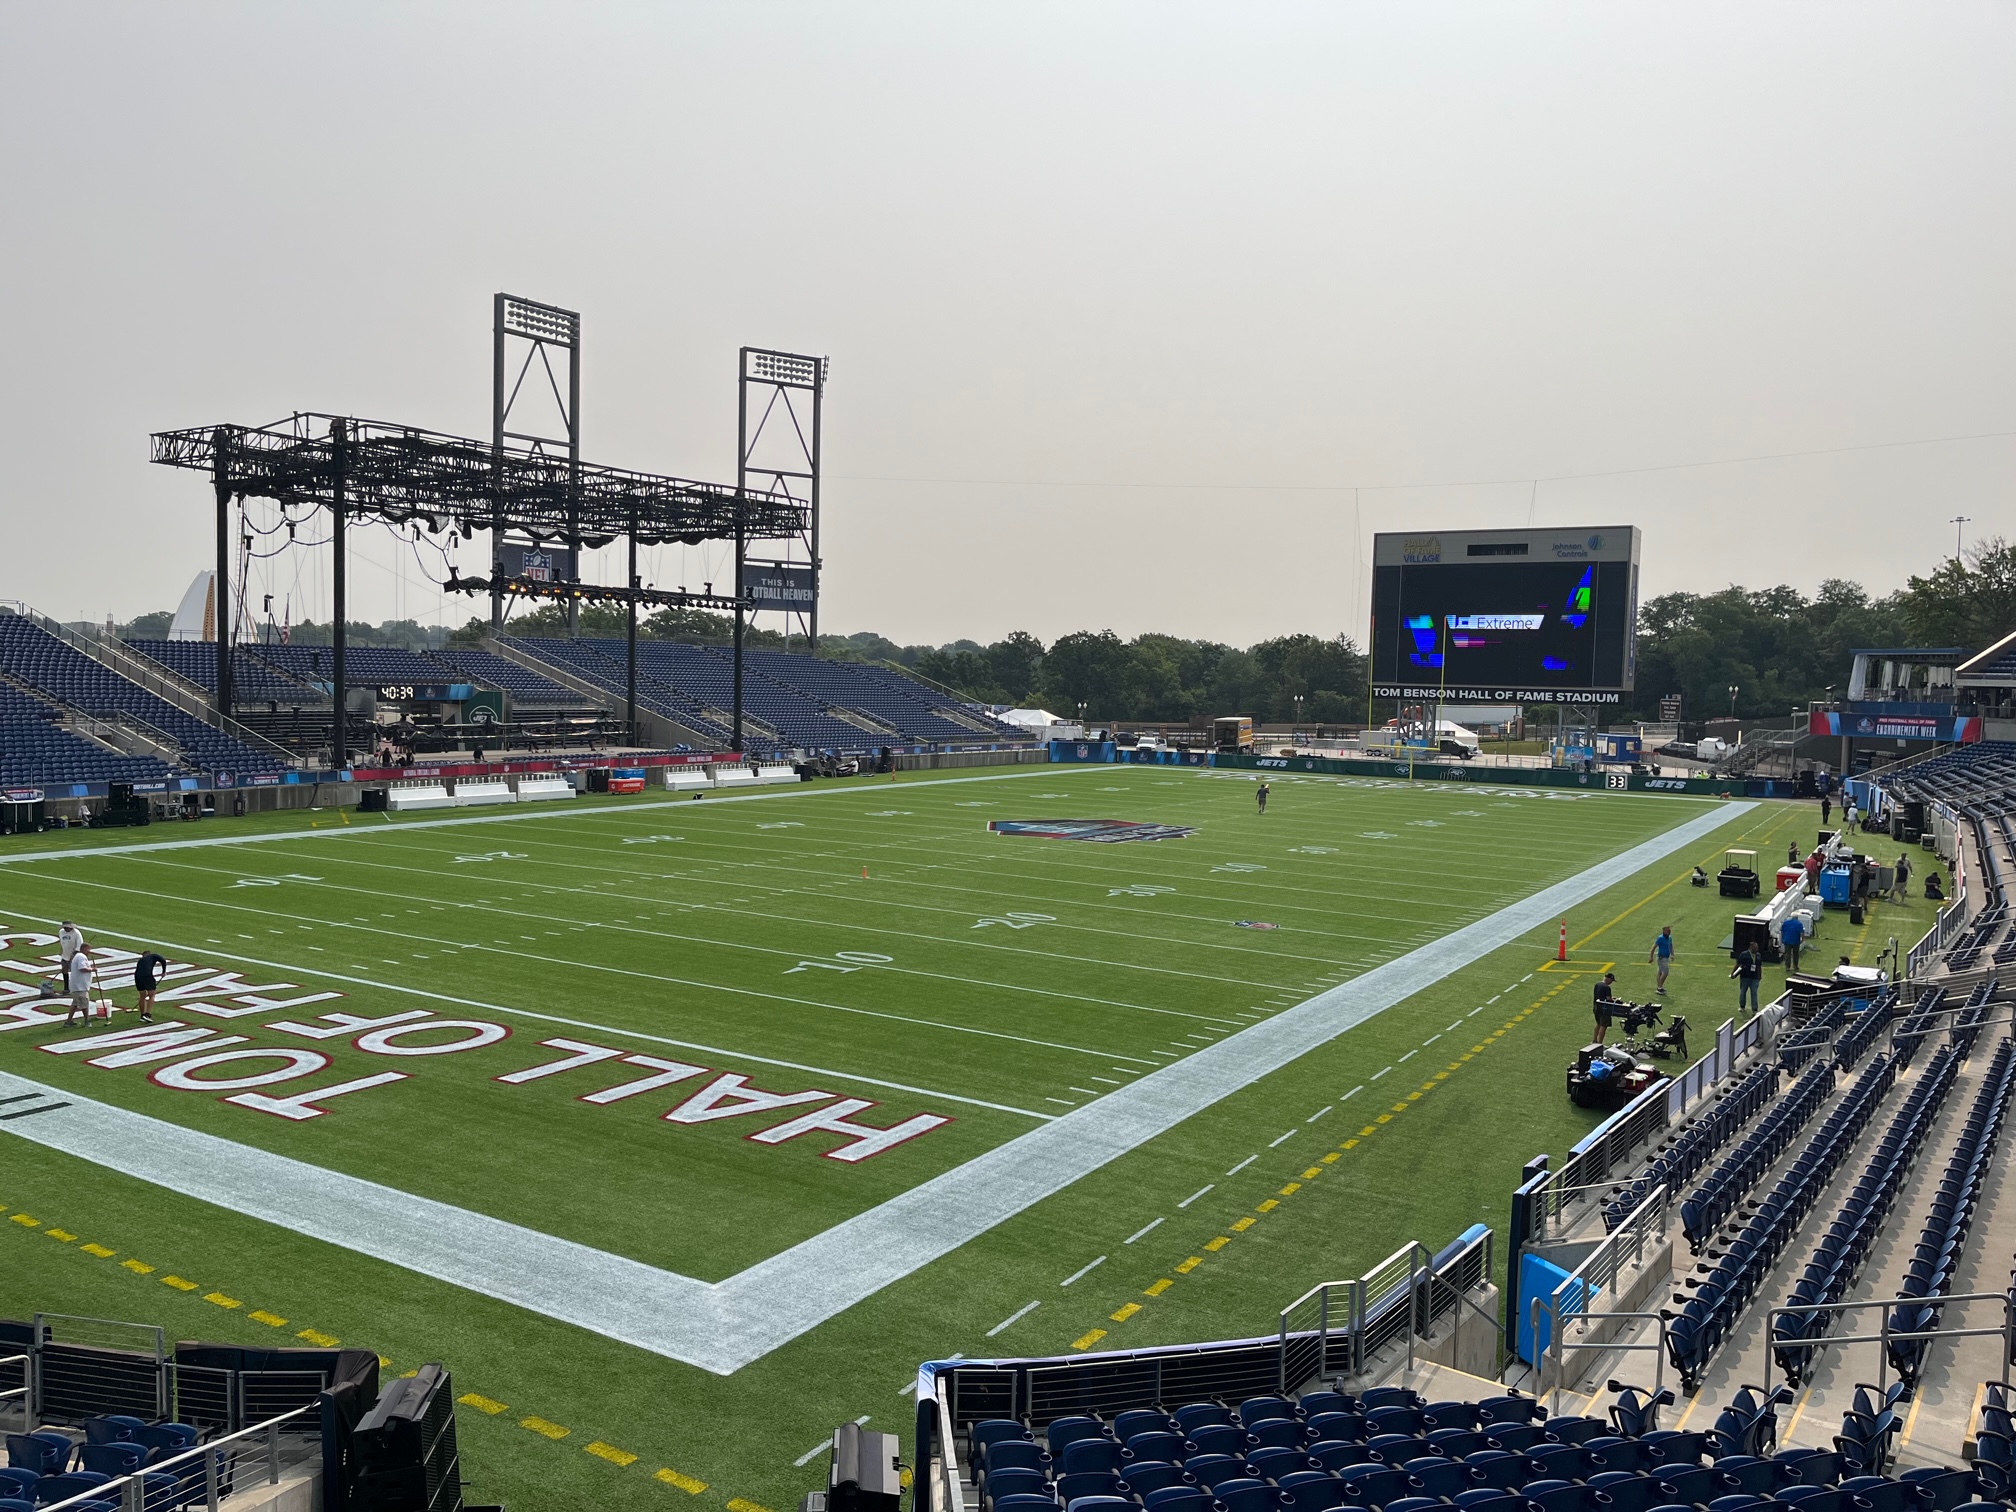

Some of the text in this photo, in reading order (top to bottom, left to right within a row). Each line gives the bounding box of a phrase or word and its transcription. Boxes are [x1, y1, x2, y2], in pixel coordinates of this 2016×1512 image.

[1552, 543, 1582, 551] Johnson
[1403, 554, 1440, 563] VILLAGE
[1557, 550, 1588, 558] Controls
[761, 578, 782, 586] THIS
[743, 586, 814, 601] FOTBALL HEAVEN
[1477, 617, 1533, 630] Extreme
[381, 686, 414, 699] 40:39
[1373, 688, 1619, 703] TOM BENSON HALL OF FAME STADIUM
[1920, 726, 1937, 737] WEEK
[1256, 759, 1288, 768] JETS
[1610, 776, 1624, 787] 33
[1644, 780, 1686, 789] JETS
[1784, 878, 1793, 887] G
[977, 912, 1057, 929] 20
[798, 951, 894, 974] 10
[263, 1009, 513, 1057] OF
[35, 1020, 414, 1121] TOM
[493, 1037, 955, 1162] HALL
